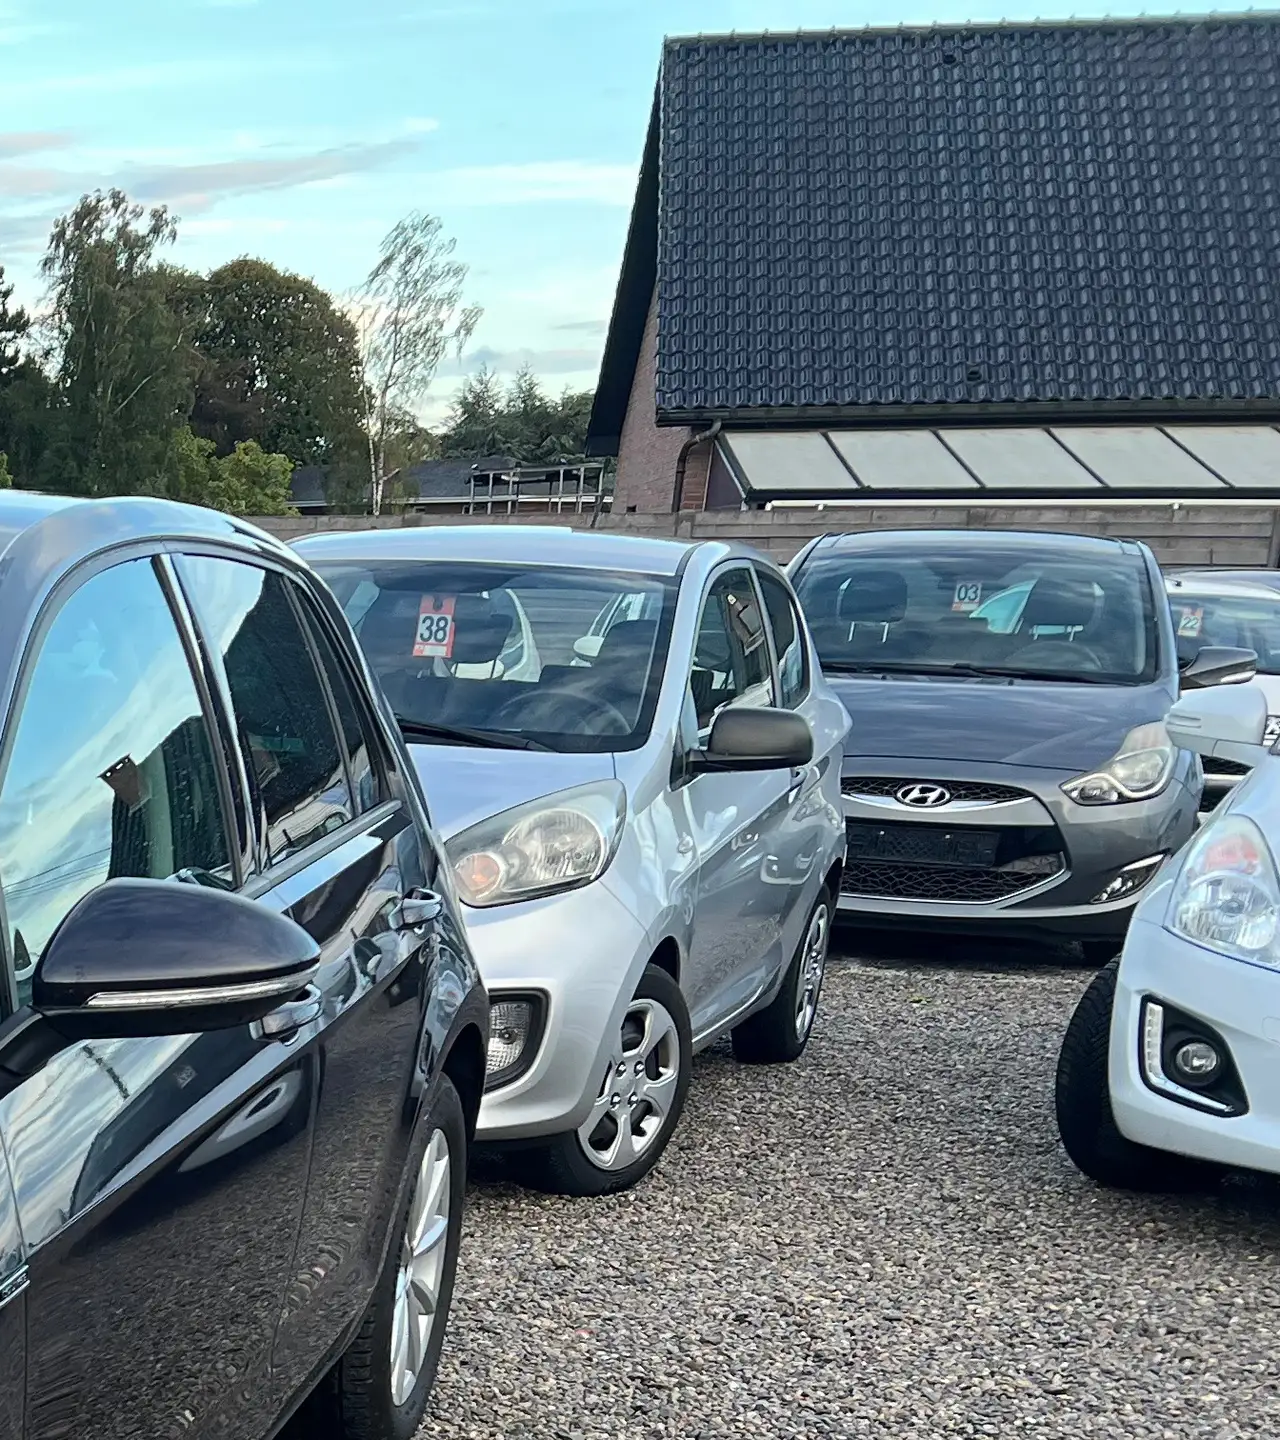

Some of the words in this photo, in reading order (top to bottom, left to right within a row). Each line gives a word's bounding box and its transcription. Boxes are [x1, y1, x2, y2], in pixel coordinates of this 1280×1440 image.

[957, 584, 979, 601] 03
[419, 615, 449, 643] 38
[1181, 616, 1199, 629] 22
